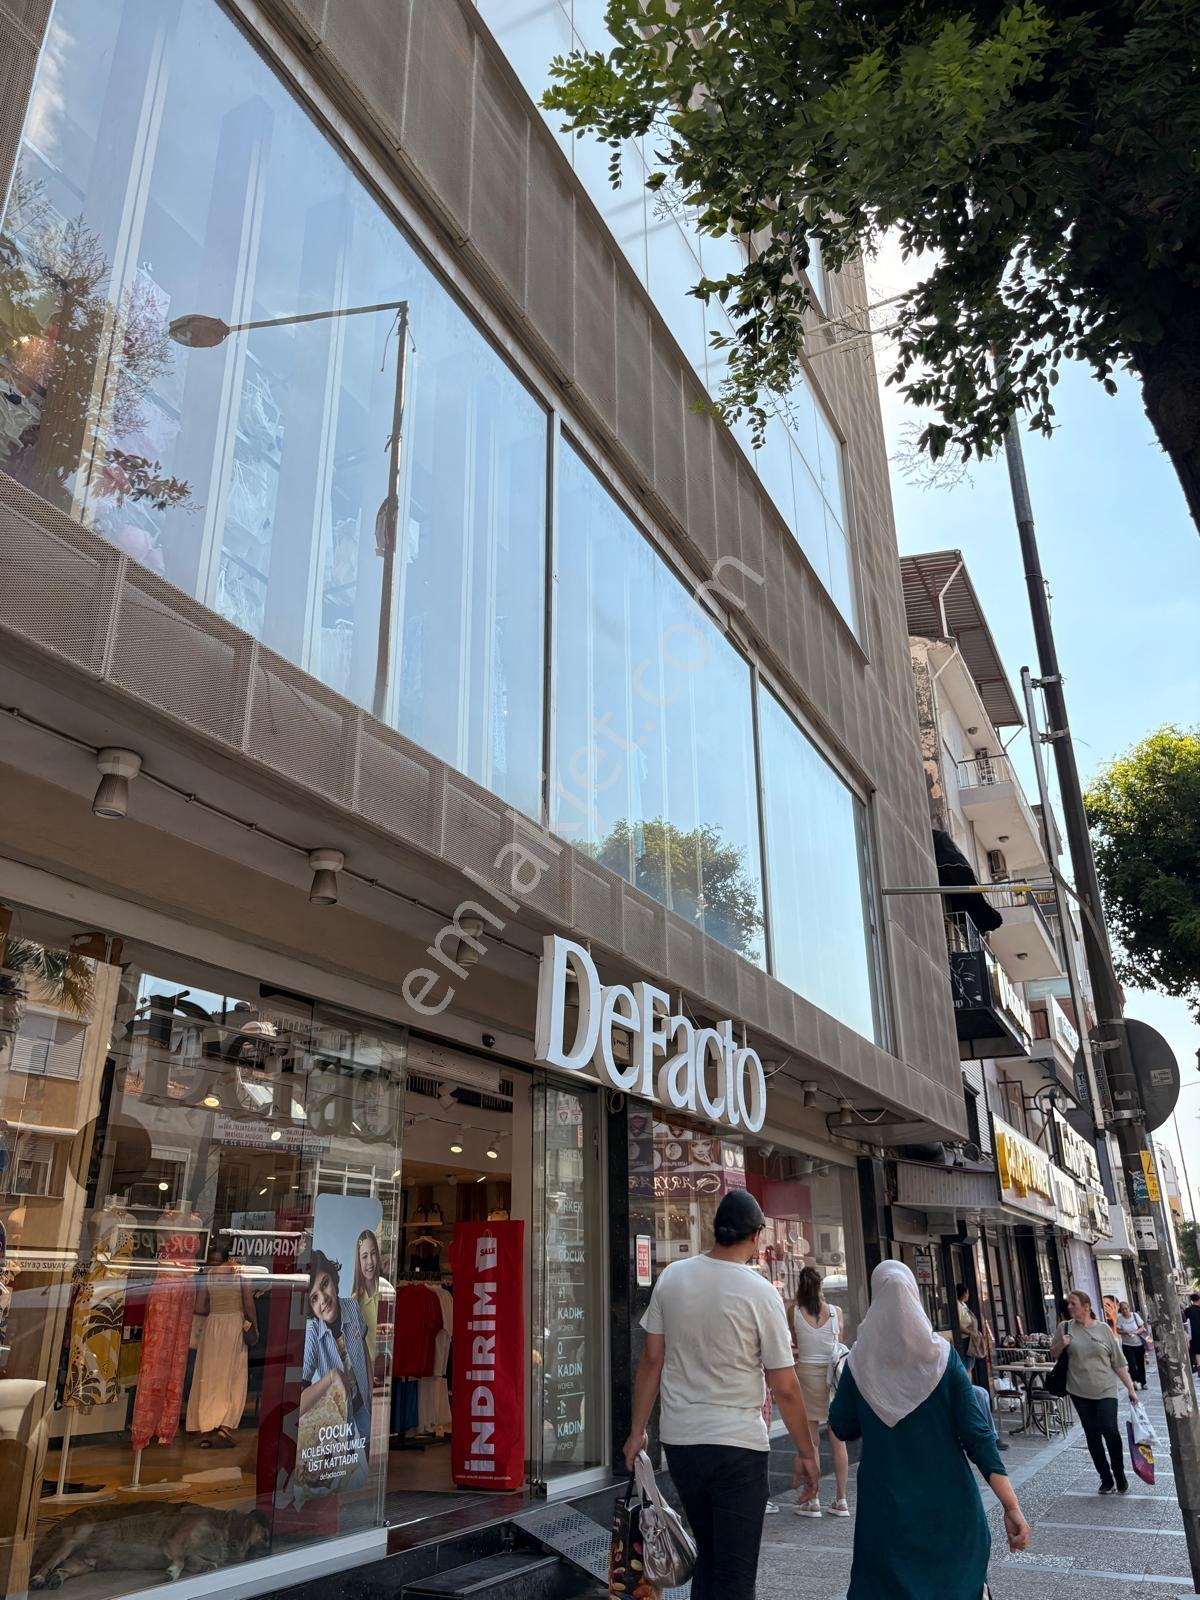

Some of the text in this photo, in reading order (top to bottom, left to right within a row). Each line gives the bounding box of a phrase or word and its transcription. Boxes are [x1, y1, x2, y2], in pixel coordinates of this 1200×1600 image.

[536, 934, 767, 1133] DeFacto
[480, 1247, 496, 1257] SALE
[464, 1281, 497, 1472] İNDİRİM
[557, 1362, 583, 1378] KADIN
[318, 1422, 354, 1445] ÇOCUK
[557, 1420, 583, 1438] KADIN
[301, 1437, 366, 1459] KOLEKSİYONUMUZ
[308, 1453, 359, 1473] ÜST KATTADIR
